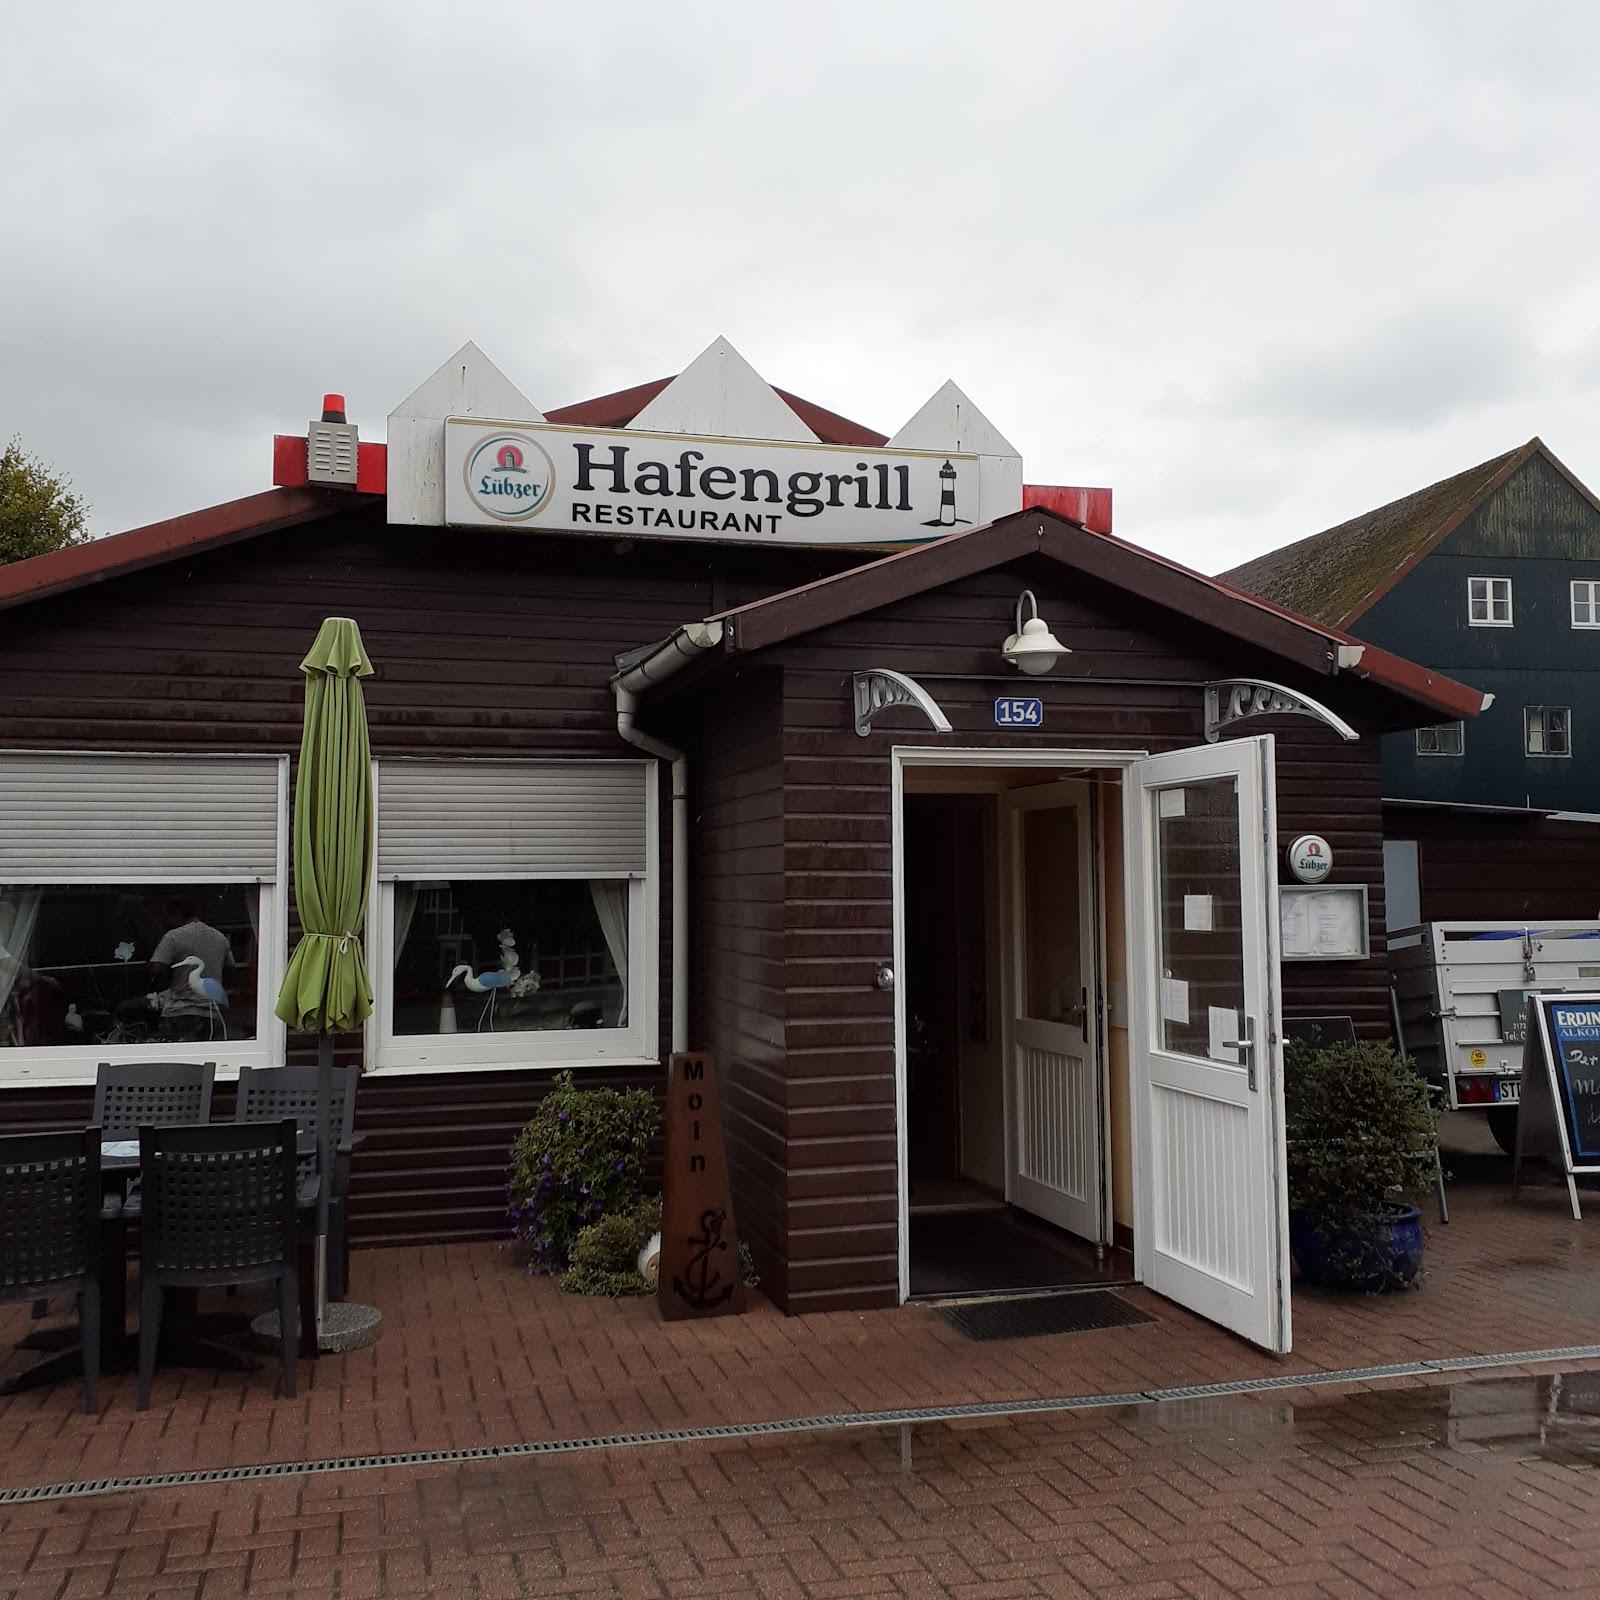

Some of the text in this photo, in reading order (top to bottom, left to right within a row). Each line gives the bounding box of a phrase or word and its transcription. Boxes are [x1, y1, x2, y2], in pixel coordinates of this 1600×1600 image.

[478, 475, 541, 499] Lübzer
[572, 443, 914, 517] Hafengrill
[572, 502, 783, 534] RESTAURANT
[1000, 701, 1038, 723] 154
[1298, 858, 1328, 872] Lübzer
